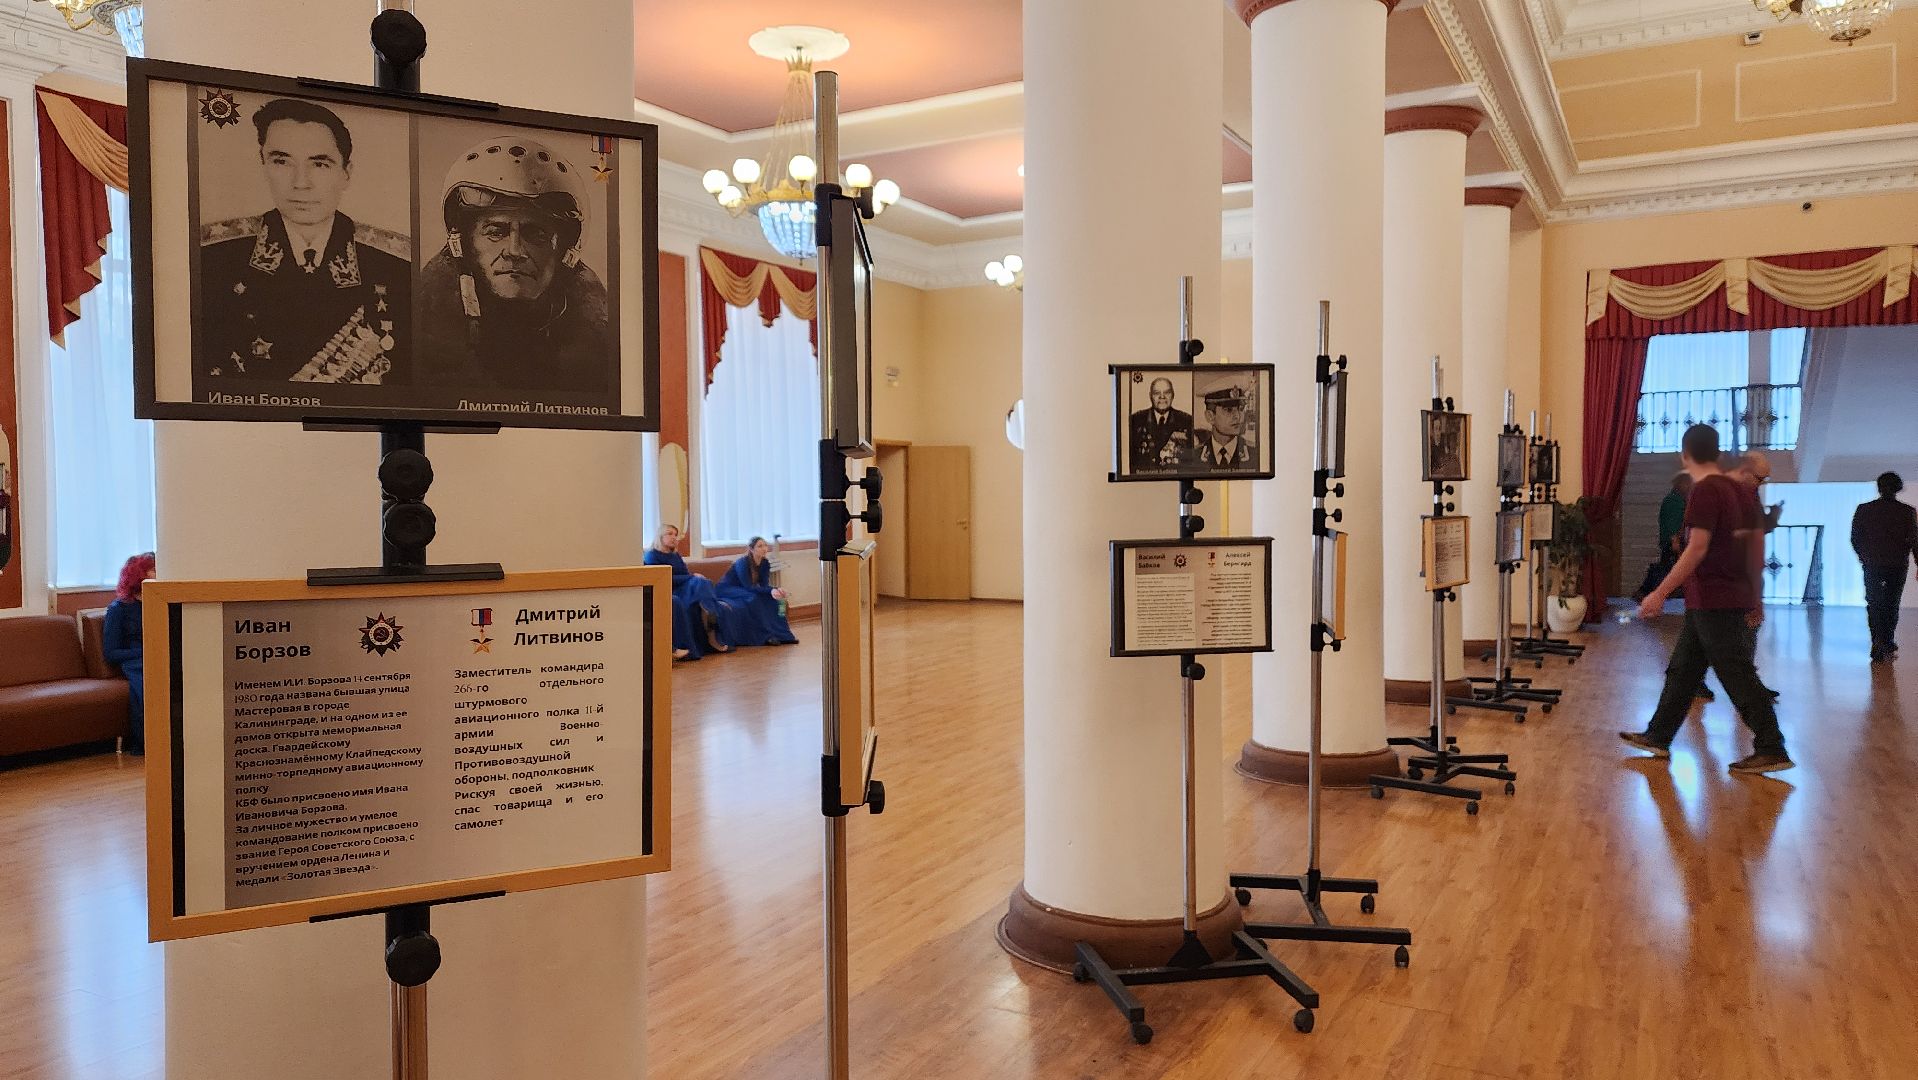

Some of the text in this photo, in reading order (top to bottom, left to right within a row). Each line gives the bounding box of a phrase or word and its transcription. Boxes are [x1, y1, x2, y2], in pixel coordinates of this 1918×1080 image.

[208, 392, 320, 406] Иван Борзов
[458, 399, 608, 415] Дмитрий Литвинов
[516, 605, 600, 625] Дмитрий
[235, 620, 291, 634] Иван
[514, 631, 604, 645] Литвинов
[235, 645, 311, 663] Борзов
[454, 662, 604, 678] Заместитель командира
[235, 680, 281, 690] Именем
[308, 676, 351, 687] Борзова
[364, 673, 411, 682] сентября
[540, 677, 604, 689] отдельного
[259, 692, 284, 702] года
[287, 689, 331, 699] названа
[334, 687, 376, 697] бывшая
[378, 685, 410, 695] улица
[235, 705, 301, 716] Мастеровая
[312, 702, 350, 713] городе
[454, 697, 527, 710] штурмового
[345, 713, 379, 722] одном
[454, 712, 539, 724] авиационного
[546, 707, 579, 717] полка
[235, 723, 402, 744] домов открыта мемориальная
[454, 721, 603, 741] армии Военно-
[273, 740, 351, 753] Гвардейскому
[454, 742, 523, 754] воздушных
[550, 738, 569, 746] сил
[235, 747, 422, 770] Краснознамённому Клайпедскому
[345, 760, 424, 772] авиационному
[454, 751, 571, 771] Противовоздушной
[512, 765, 594, 780] подполковник
[235, 785, 269, 795] полку
[235, 798, 258, 808] КБФ
[261, 795, 290, 805] было
[292, 791, 350, 805] присвоено
[376, 785, 408, 794] Ивана
[454, 790, 495, 800] Рискуя
[509, 784, 543, 795] своей
[454, 806, 480, 815] спас
[494, 799, 552, 811] товарища
[586, 793, 603, 801] его
[235, 808, 298, 821] Ивановича
[235, 826, 250, 834] За
[251, 822, 293, 833] личное
[295, 816, 348, 829] мужество
[359, 811, 398, 822] умелое
[454, 819, 503, 830] самолет
[235, 821, 419, 848] командование полком присвоено
[235, 850, 276, 861] звание
[278, 846, 309, 856] Героя
[311, 839, 371, 851] Советского
[235, 849, 390, 874] вручением ордена Ленина и
[235, 876, 279, 888] медали
